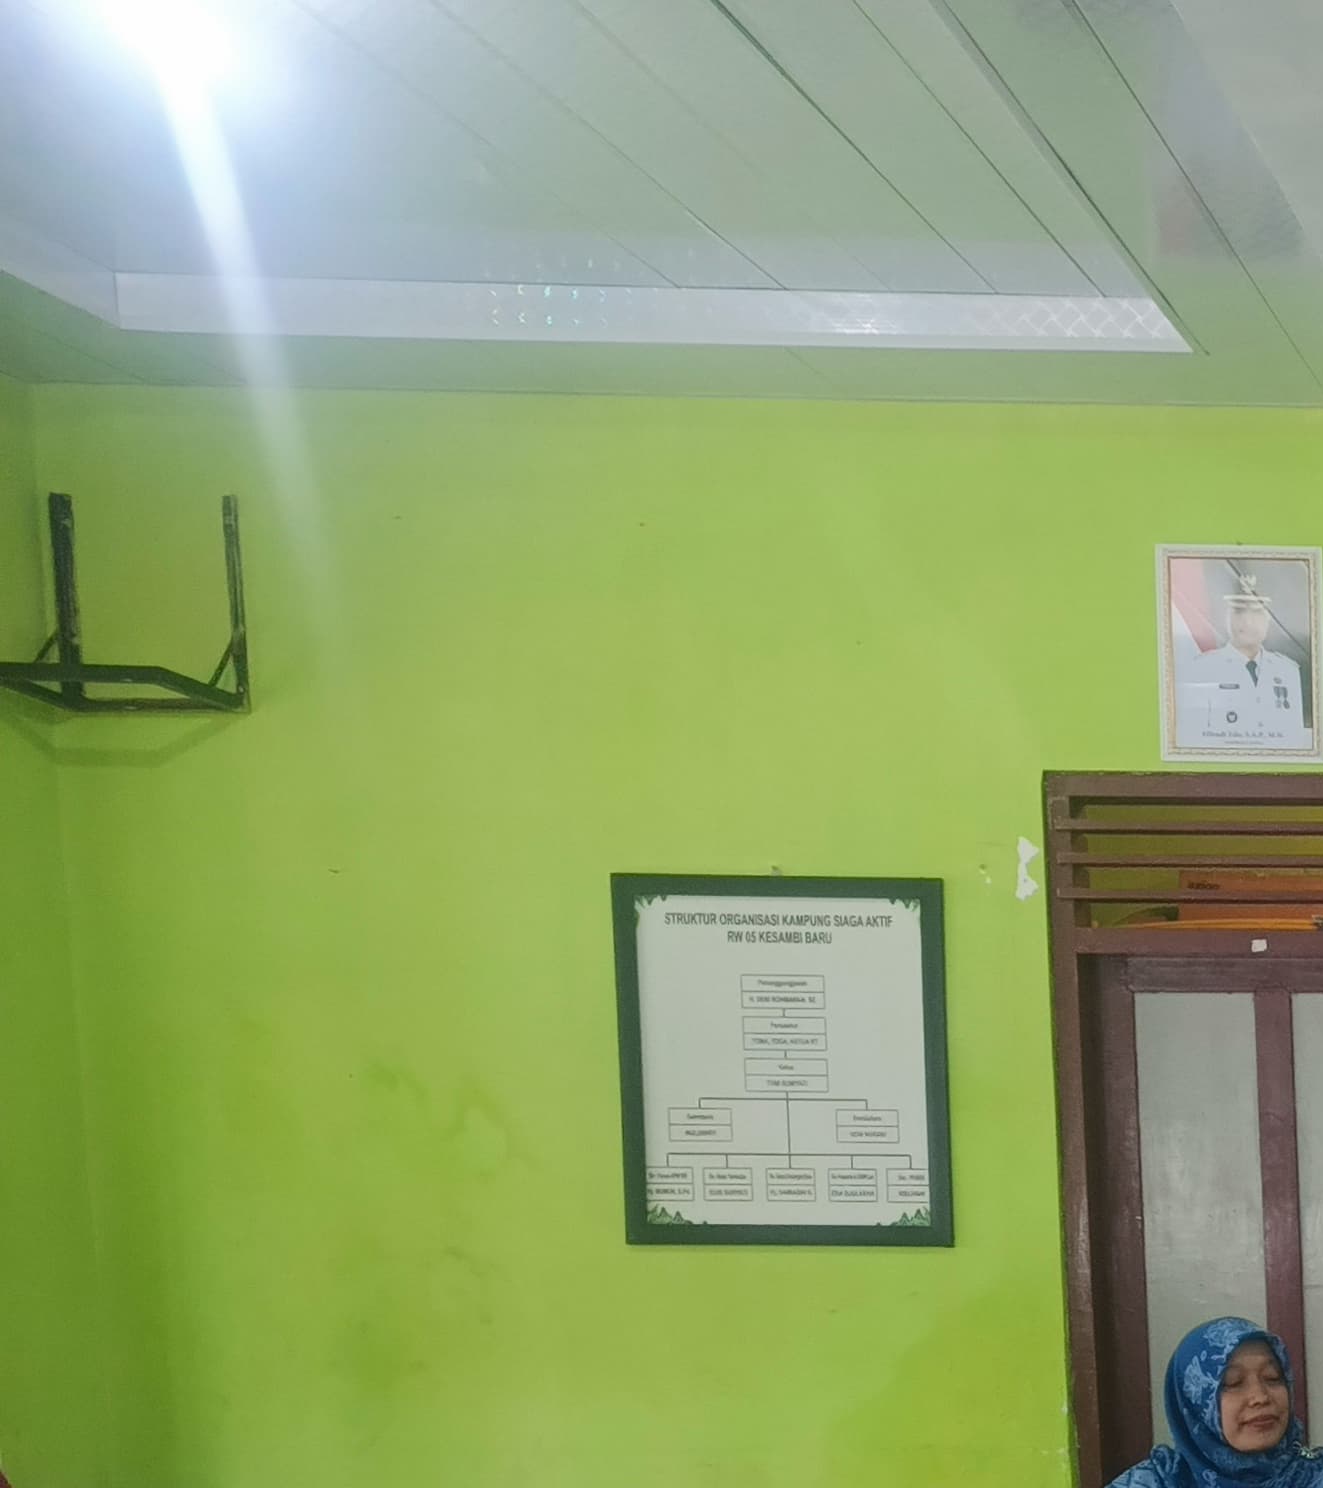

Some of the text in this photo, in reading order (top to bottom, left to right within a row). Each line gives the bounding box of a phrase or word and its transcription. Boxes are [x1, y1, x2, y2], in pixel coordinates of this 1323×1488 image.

[664, 912, 894, 928] STRUKTUR ORGANISASI KAMPUNG SIAGA AKTIF
[727, 931, 833, 944] RW 05 KESAMBI BARU
